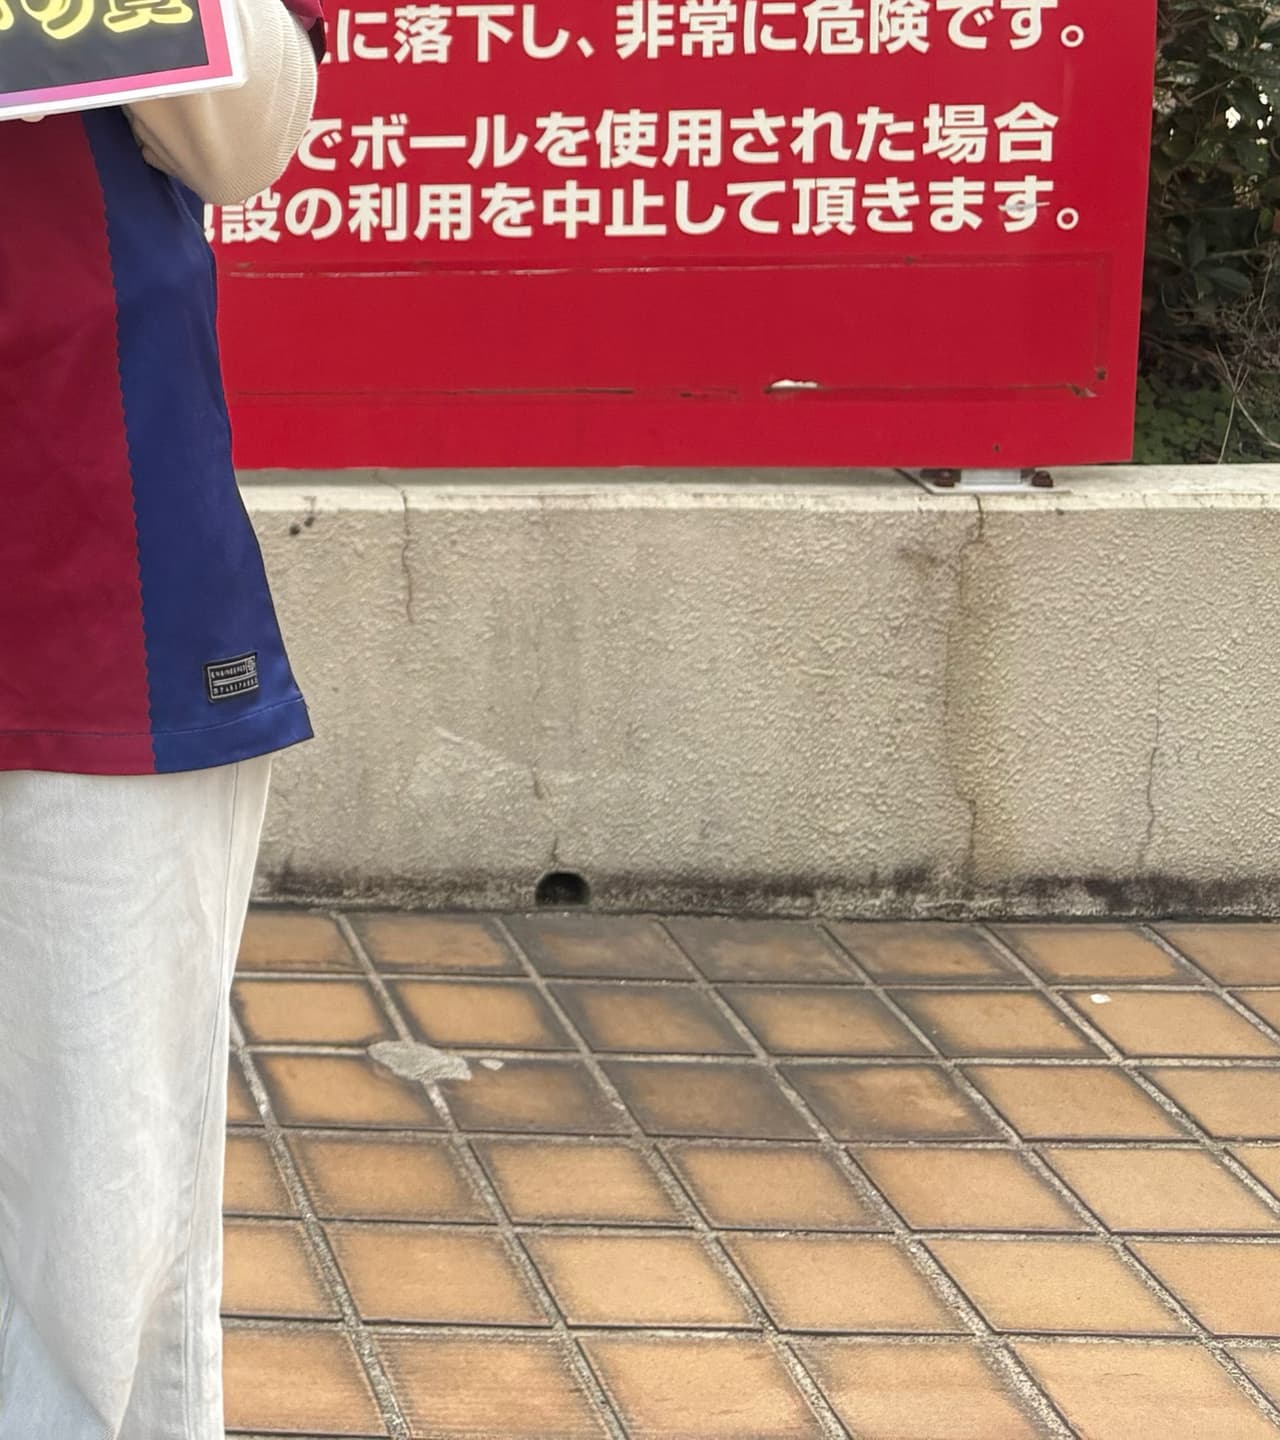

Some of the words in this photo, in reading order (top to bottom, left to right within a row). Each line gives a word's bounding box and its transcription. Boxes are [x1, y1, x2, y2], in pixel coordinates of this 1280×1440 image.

[296, 101, 1059, 171] でボールを使用された場合
[204, 175, 1080, 244] 設の利用を中止して頂きます。
